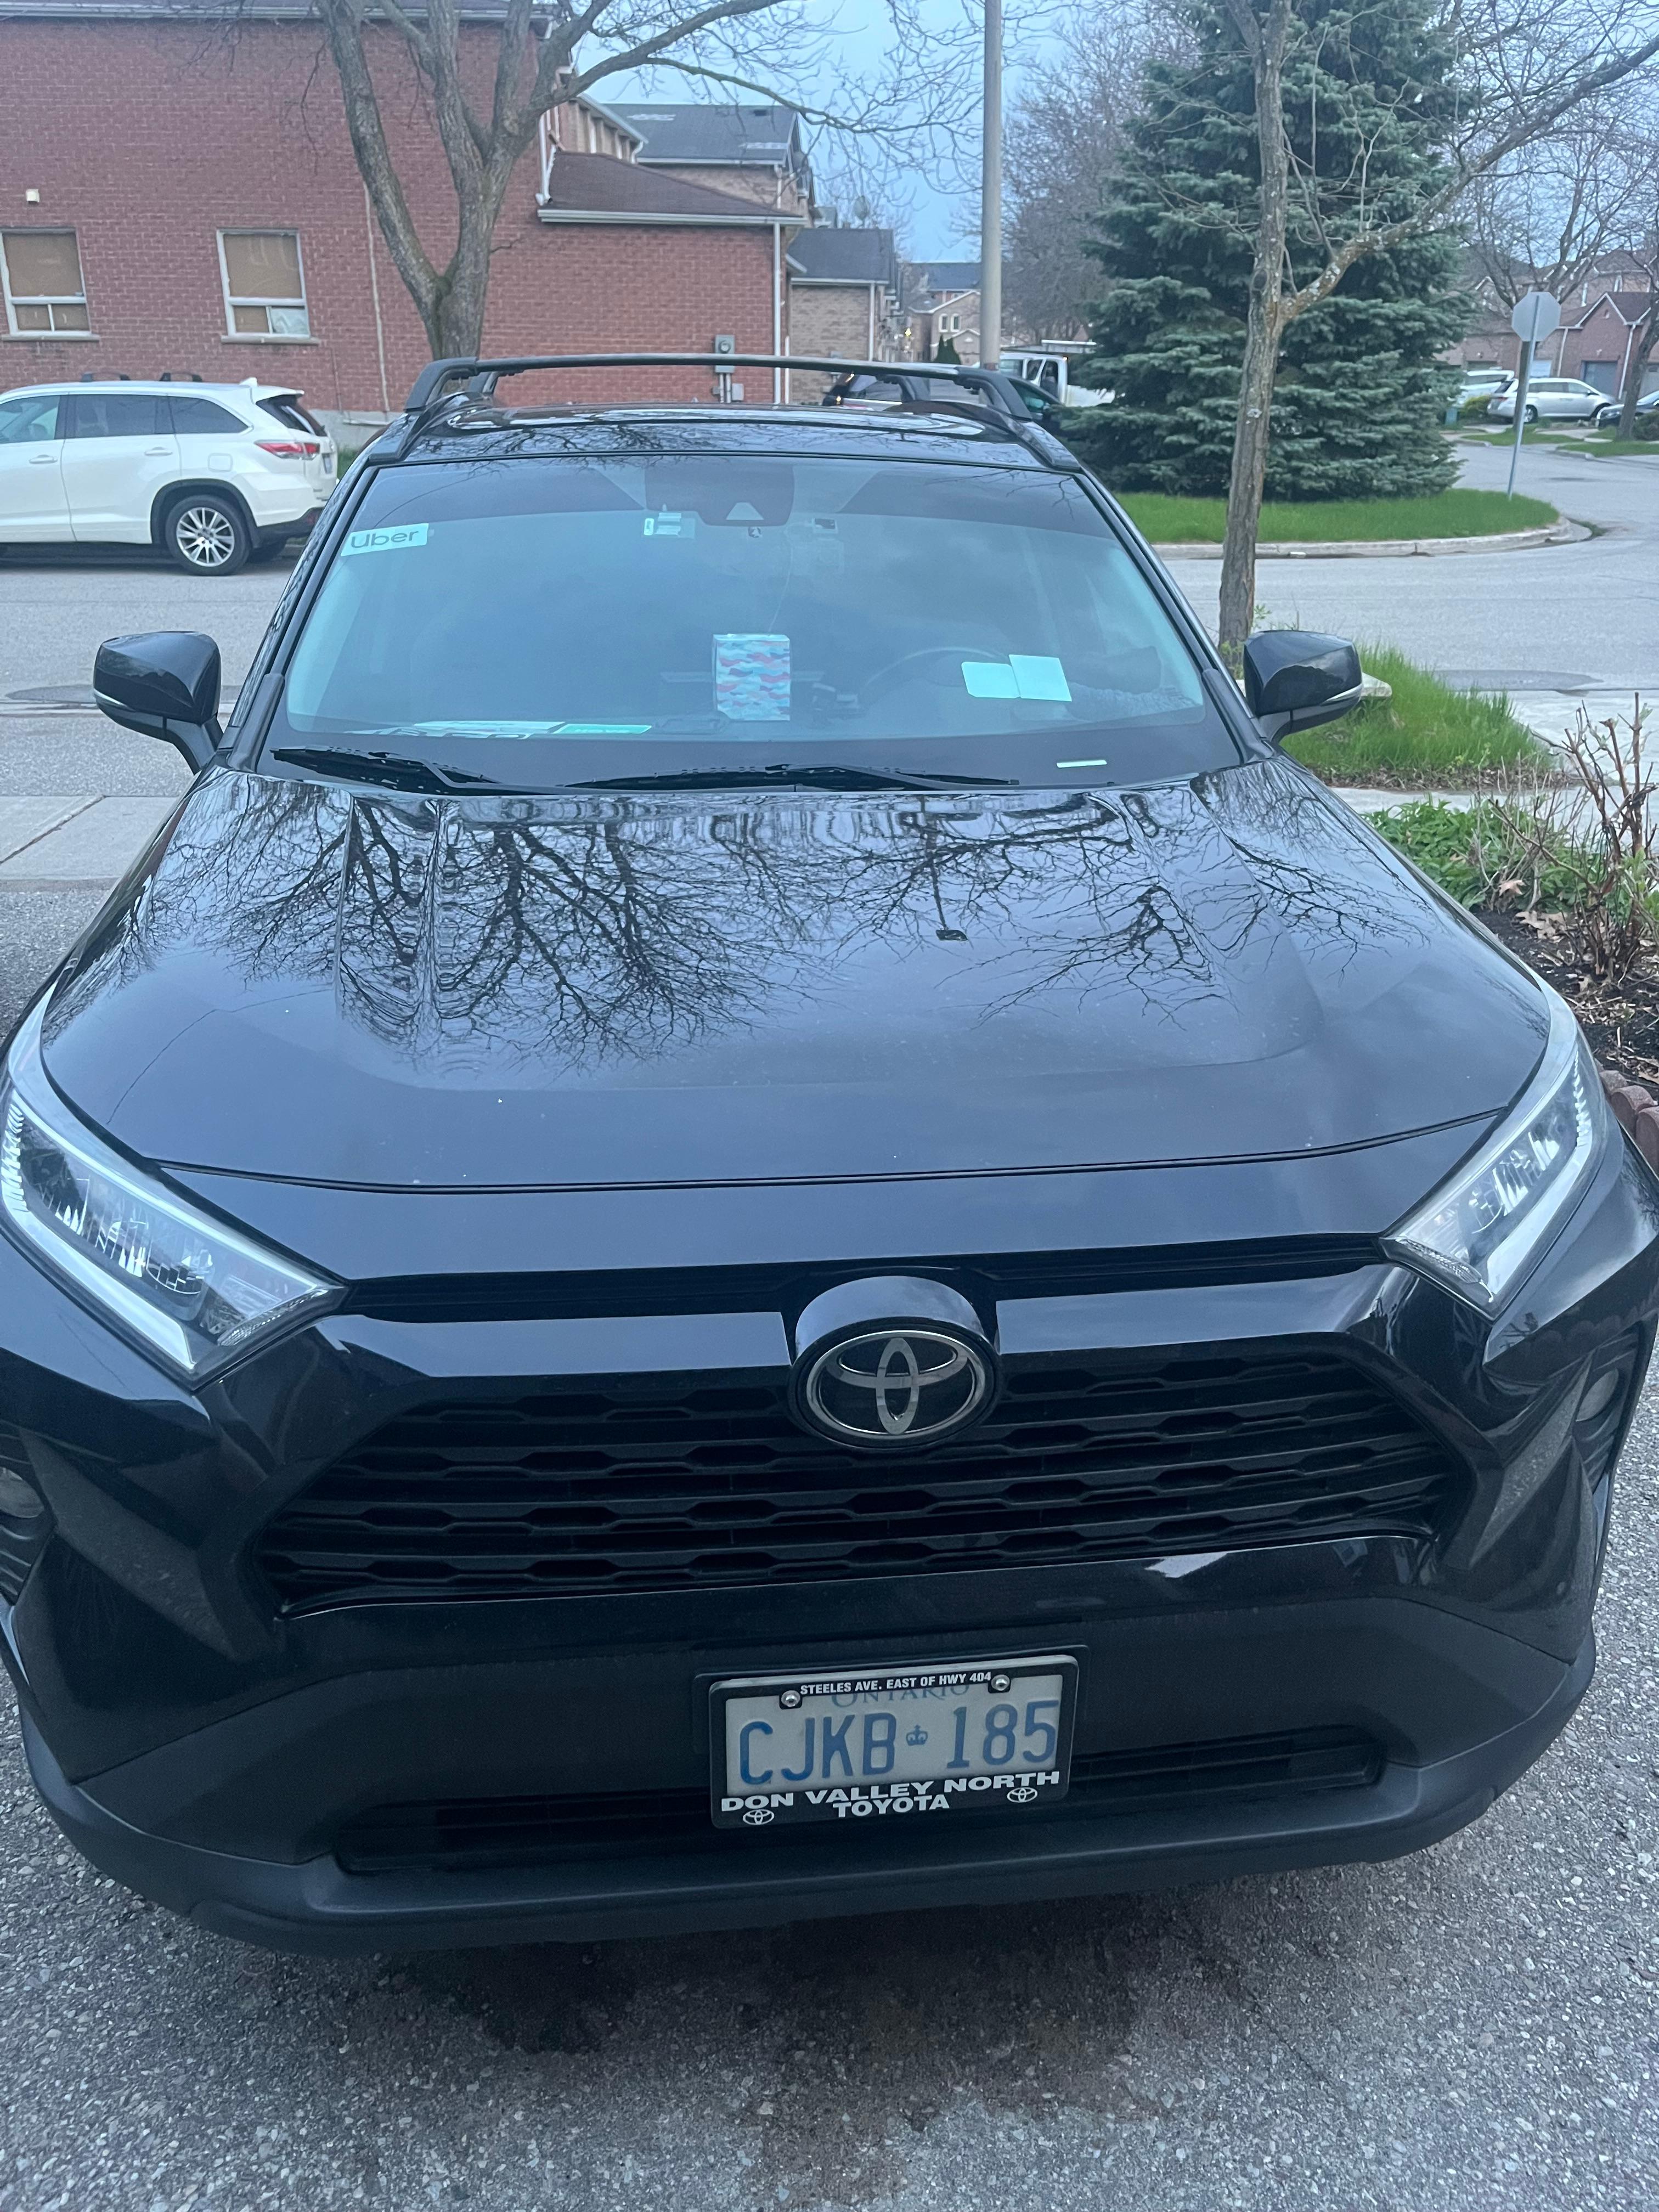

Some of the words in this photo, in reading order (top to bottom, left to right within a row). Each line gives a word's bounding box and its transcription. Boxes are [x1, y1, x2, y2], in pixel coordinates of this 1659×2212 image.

[351, 531, 419, 549] Uber
[800, 1682, 851, 1695] STEELES
[855, 1680, 882, 1691] AVE.
[886, 1678, 917, 1689] EAST
[920, 1675, 935, 1687] OF
[939, 1673, 967, 1685] HWY
[969, 1672, 991, 1683] 404
[740, 1712, 897, 1786] CJKB
[946, 1700, 1059, 1769] 185
[721, 1792, 794, 1812] DON
[805, 1781, 934, 1804] VALLEY
[944, 1771, 1060, 1793] NORTH
[833, 1794, 950, 1818] TOYOTA
